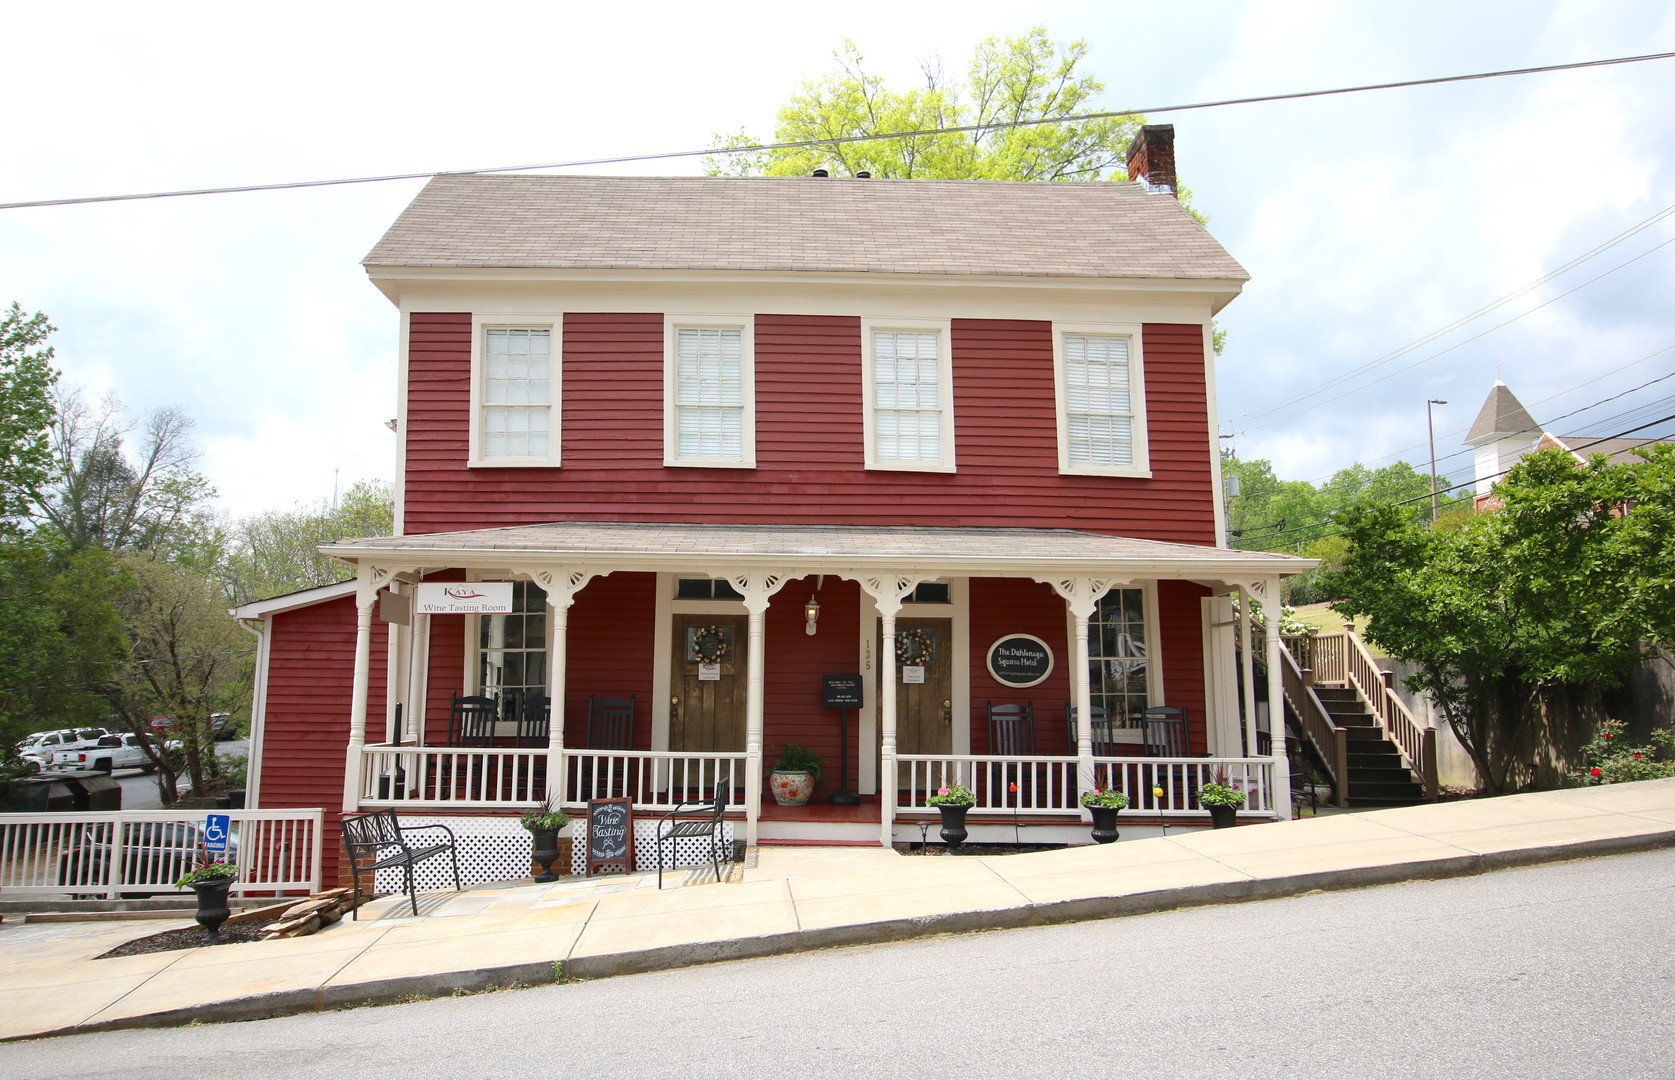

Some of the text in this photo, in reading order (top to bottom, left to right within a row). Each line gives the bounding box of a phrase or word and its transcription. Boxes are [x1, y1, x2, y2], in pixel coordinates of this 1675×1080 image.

[444, 587, 476, 596] KAYA
[423, 603, 506, 613] Wine Tasting Room
[998, 647, 1011, 656] The
[1021, 658, 1038, 666] Hotel
[598, 812, 621, 826] Wine
[592, 825, 626, 841] Tasting
